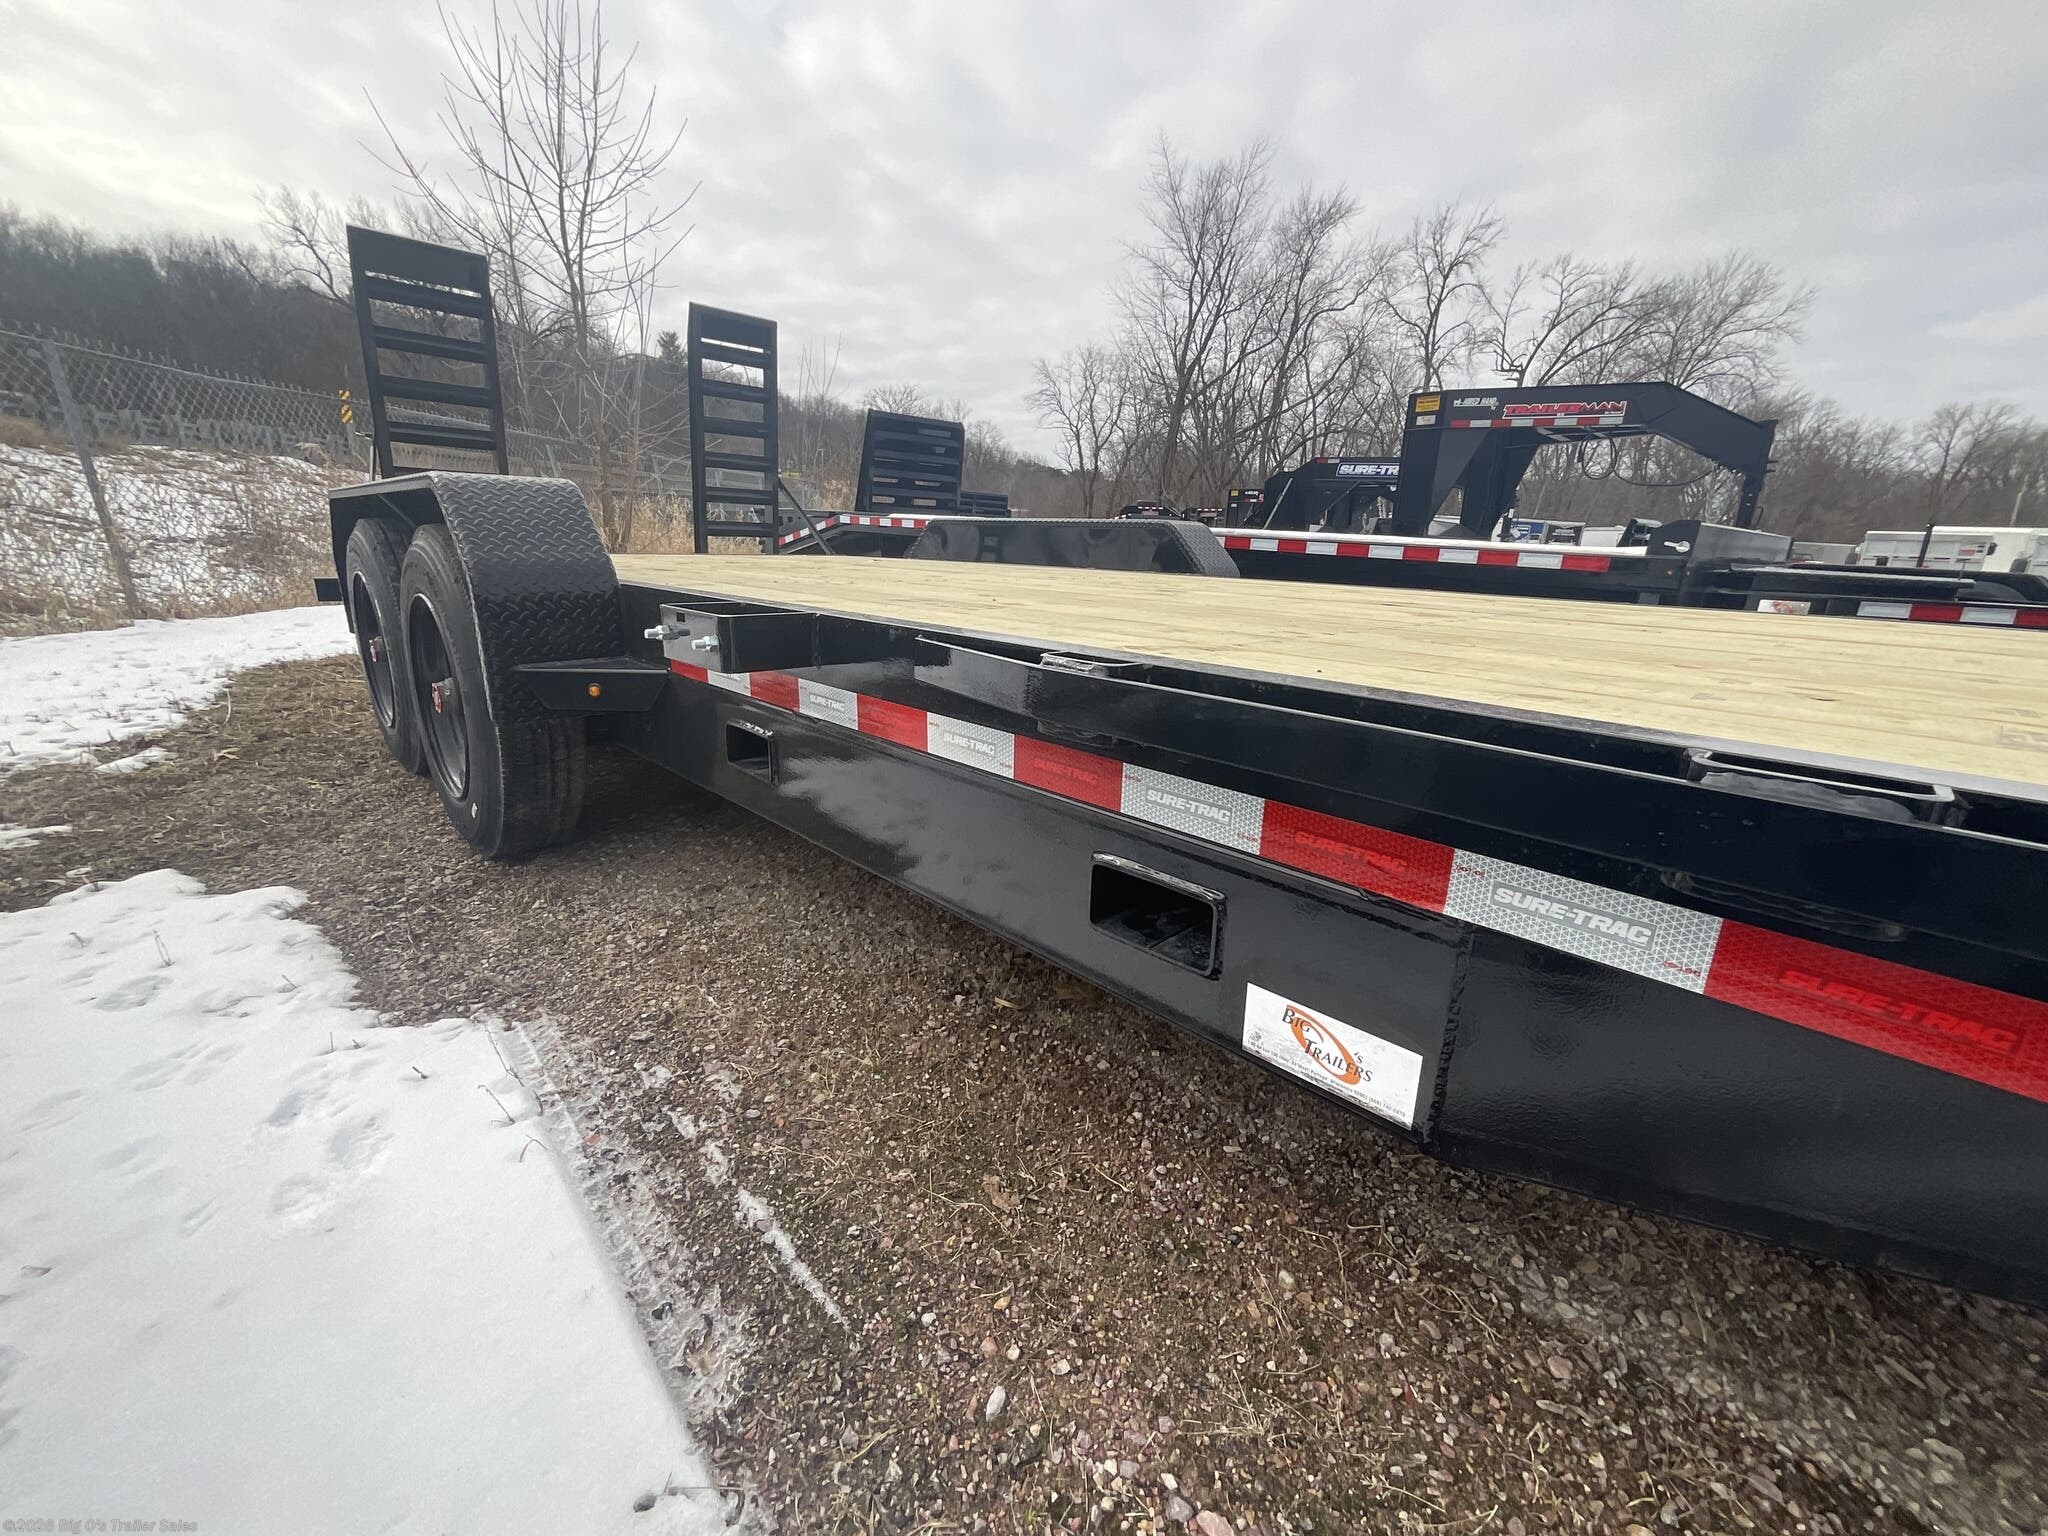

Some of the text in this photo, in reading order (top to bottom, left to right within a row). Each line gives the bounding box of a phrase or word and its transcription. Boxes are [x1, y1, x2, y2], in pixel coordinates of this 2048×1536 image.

[1339, 464, 1399, 475] SURE-TR
[809, 694, 845, 711] SURE-TRAC
[943, 732, 996, 755] SURE-TRAC
[1033, 758, 1097, 784] SURE-TRAC
[1146, 789, 1231, 824] SURE-TRAC
[1295, 831, 1407, 873] SURE-TRAC
[1494, 887, 1651, 943] SURE-TRAC
[1778, 970, 2017, 1051] SURE-TRAC
